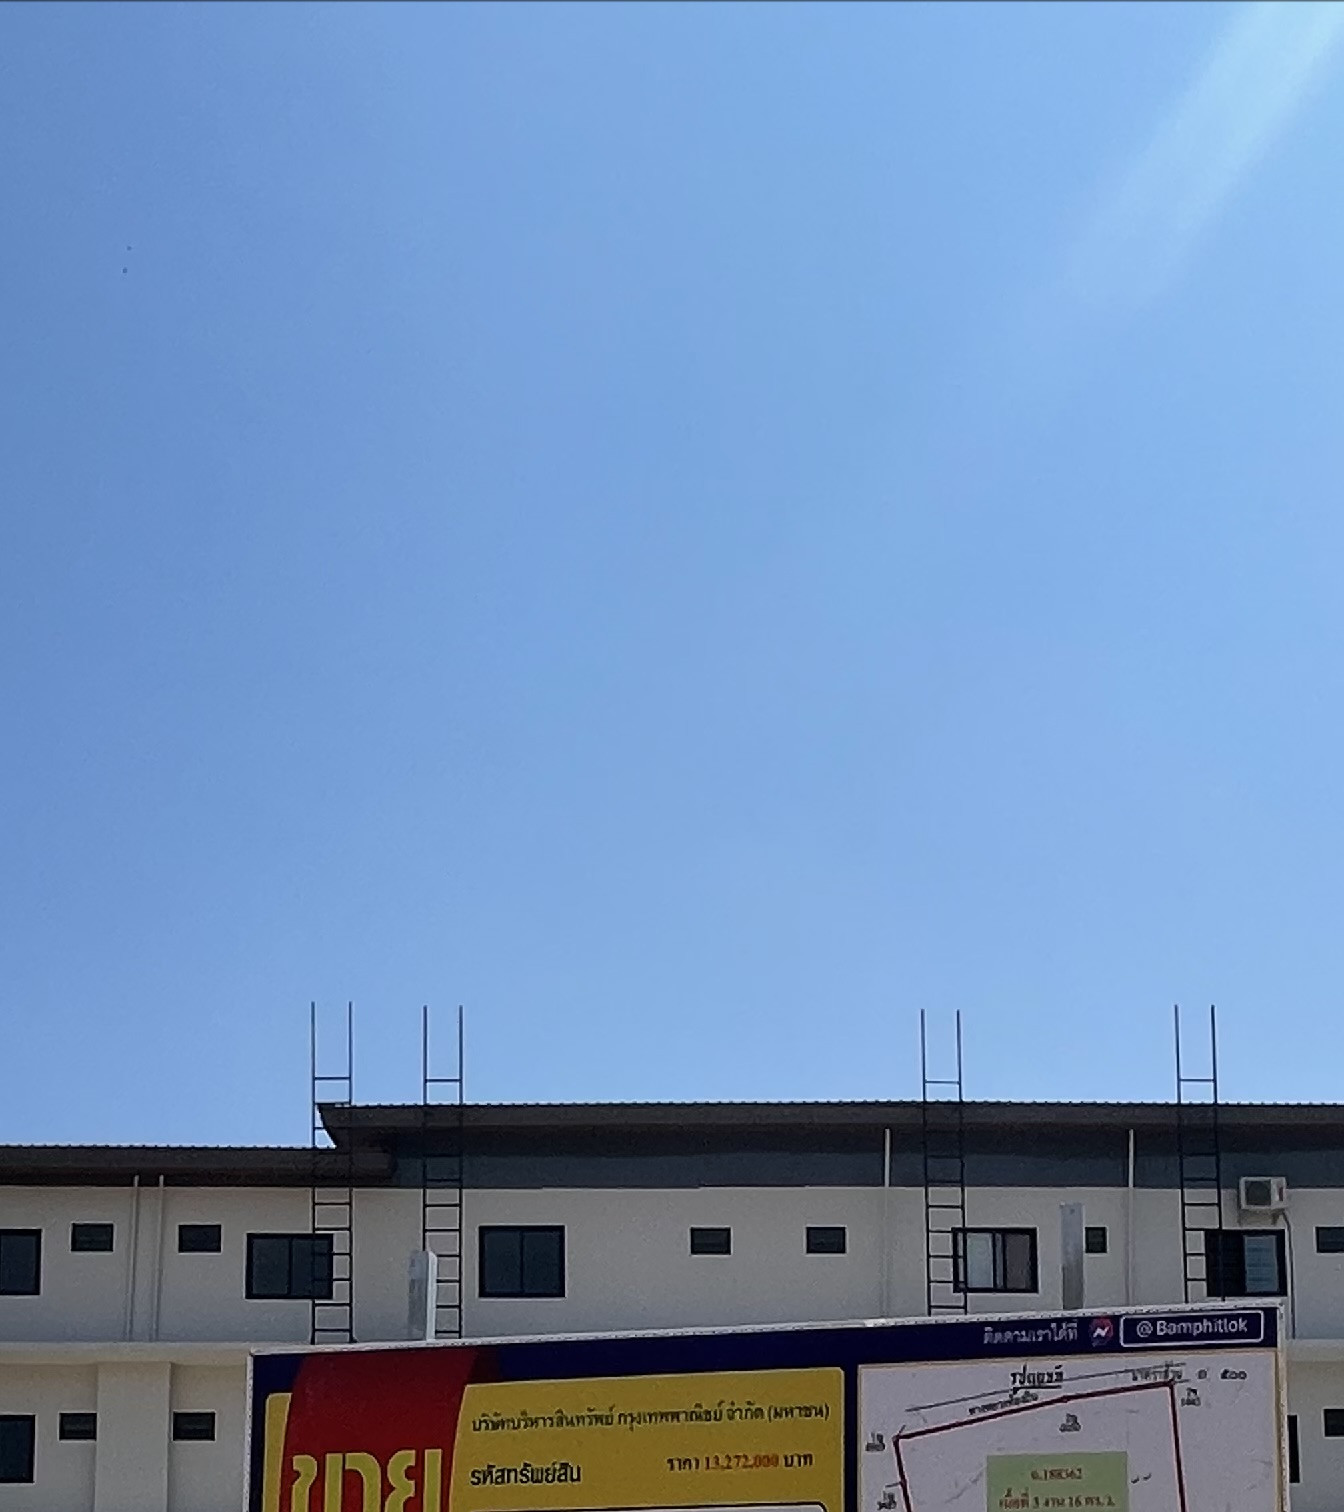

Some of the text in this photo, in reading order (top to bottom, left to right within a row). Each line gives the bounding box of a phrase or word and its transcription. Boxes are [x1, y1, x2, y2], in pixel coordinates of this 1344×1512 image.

[726, 1401, 763, 1423] จำกัด
[767, 1403, 830, 1424] (มหาชน)
[470, 1461, 582, 1487] รหัสทรัพย์สิน
[666, 1456, 701, 1473] ราคา
[783, 1452, 813, 1469] บาท
